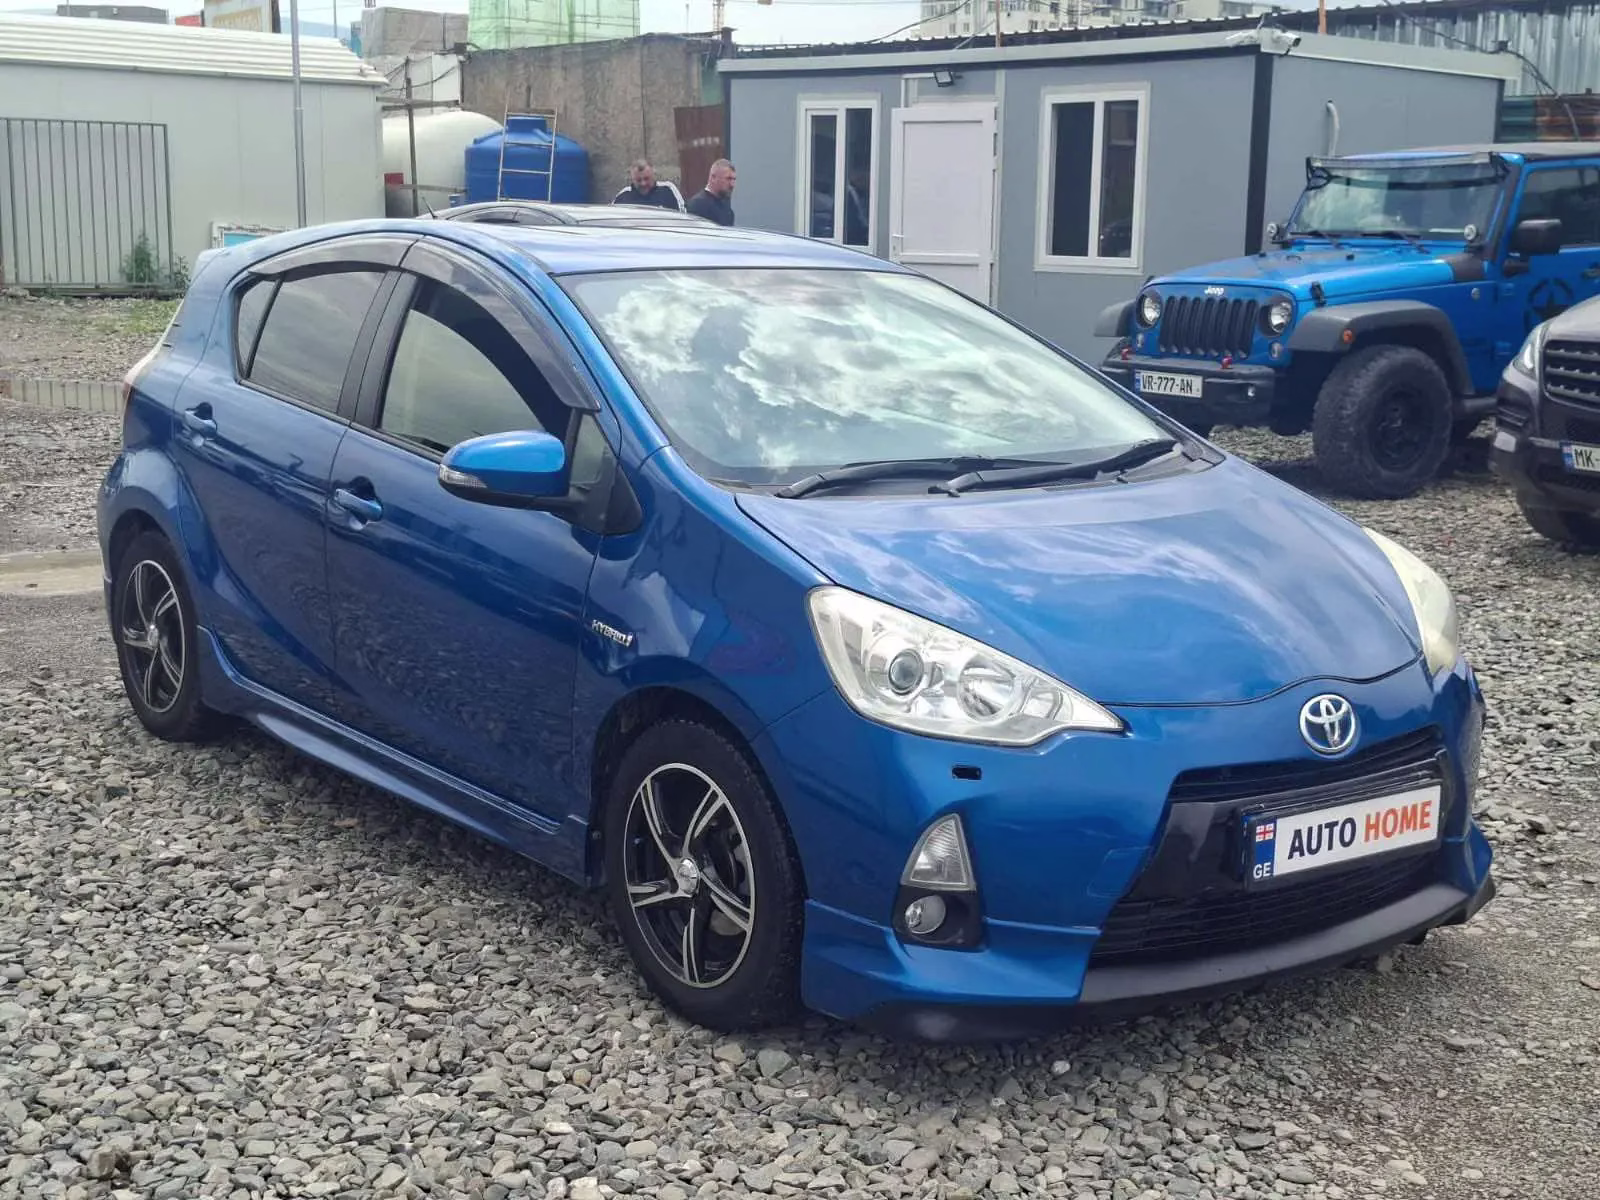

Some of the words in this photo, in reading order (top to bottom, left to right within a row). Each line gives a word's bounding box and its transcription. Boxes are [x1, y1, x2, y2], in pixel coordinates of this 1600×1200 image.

[1142, 374, 1193, 394] VR-777-AN
[592, 619, 632, 647] HYBRID
[1287, 817, 1357, 860] AUTO
[1363, 800, 1433, 842] HOME
[1252, 862, 1272, 879] GE
